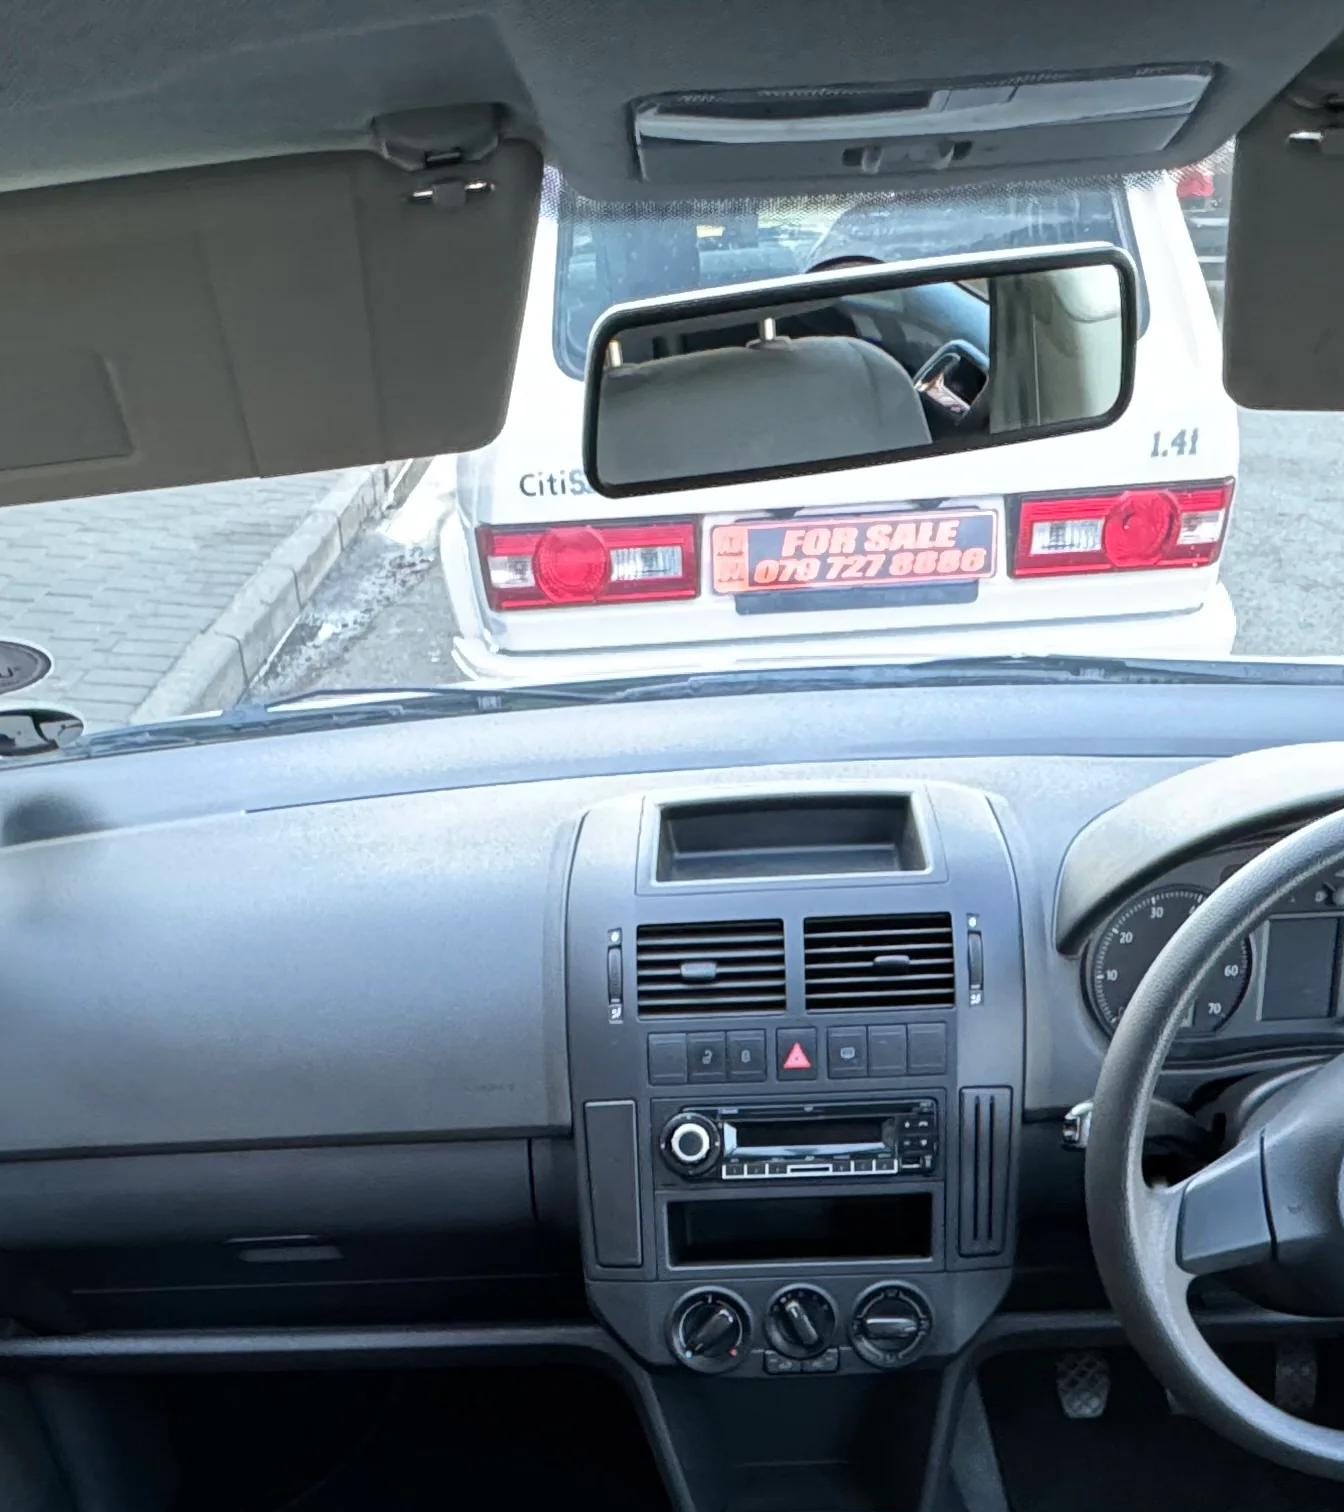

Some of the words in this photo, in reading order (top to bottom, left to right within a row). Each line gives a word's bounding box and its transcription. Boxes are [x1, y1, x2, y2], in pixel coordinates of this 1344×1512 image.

[518, 468, 594, 497] CitiS
[781, 526, 859, 557] FOR
[863, 519, 960, 552] SALE
[825, 553, 886, 580] 727
[1149, 906, 1164, 919] 30
[1119, 931, 1133, 944] 20
[1106, 969, 1118, 981] 10
[1224, 964, 1239, 977] 60
[1208, 1002, 1222, 1014] 70
